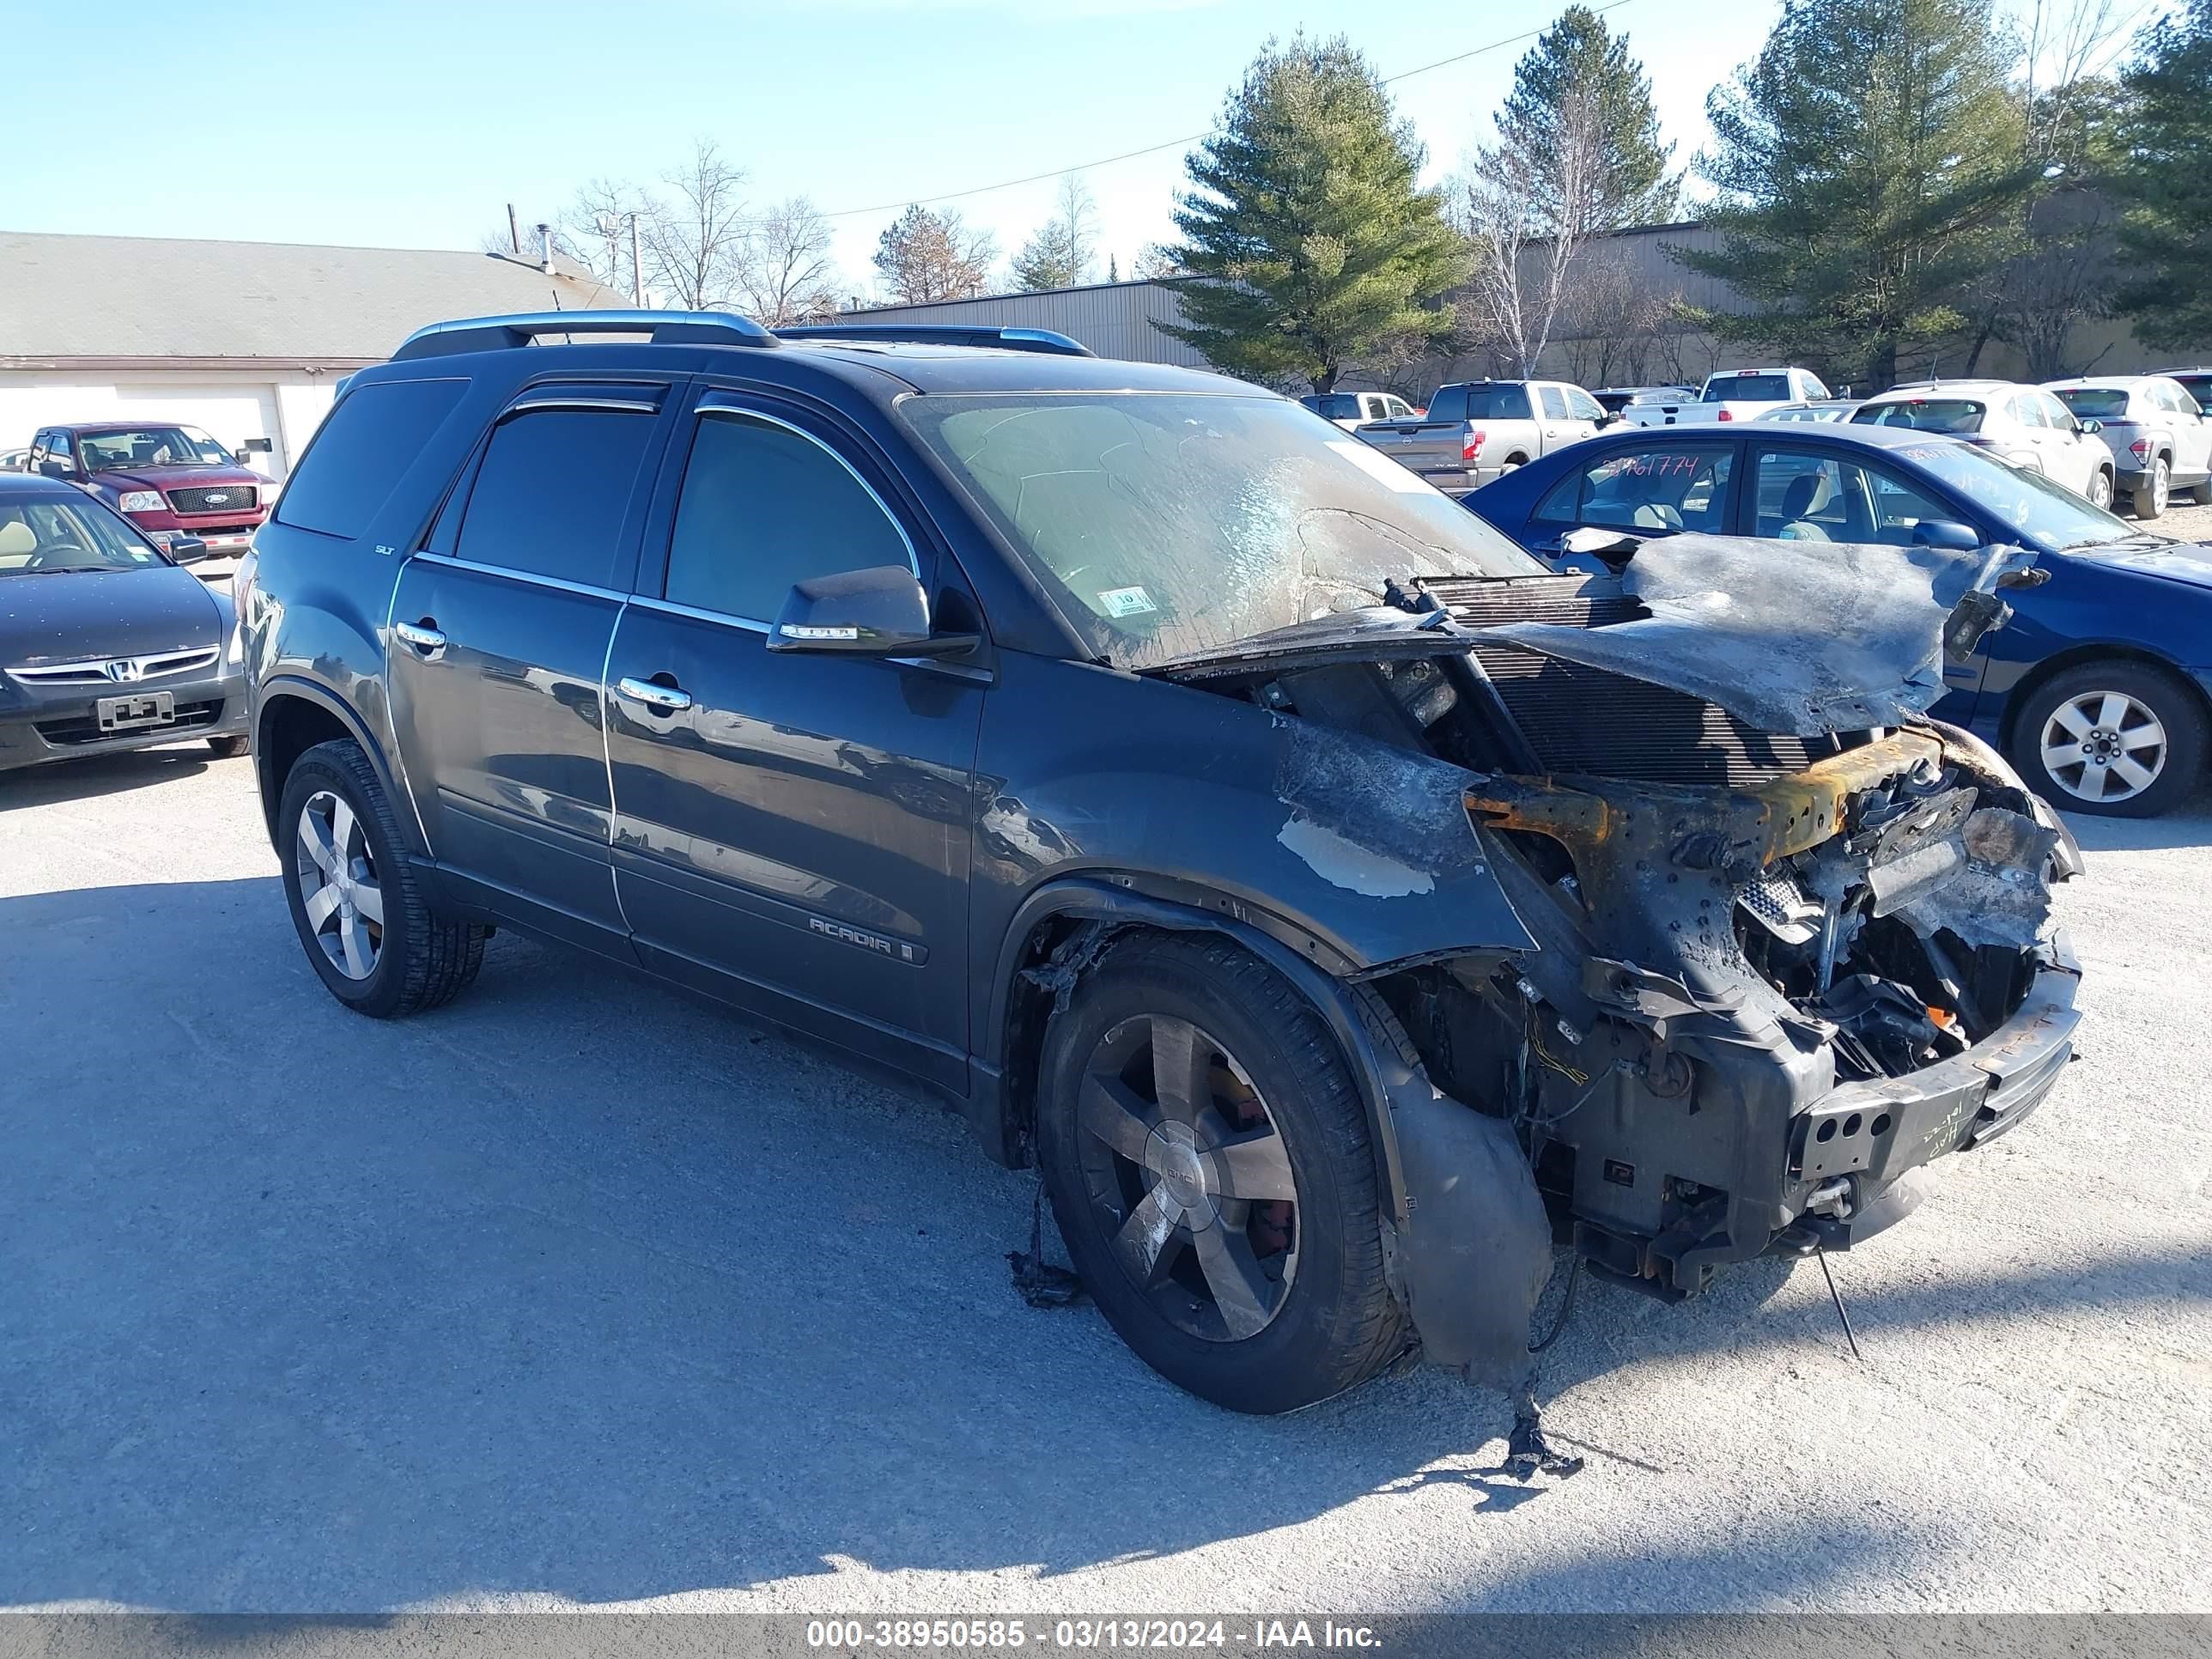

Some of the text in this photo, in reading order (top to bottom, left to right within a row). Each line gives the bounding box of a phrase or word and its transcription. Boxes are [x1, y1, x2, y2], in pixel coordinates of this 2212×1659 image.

[374, 544, 395, 556] SLT
[809, 918, 891, 954] ACADIA
[1167, 1168, 1195, 1185] GMC
